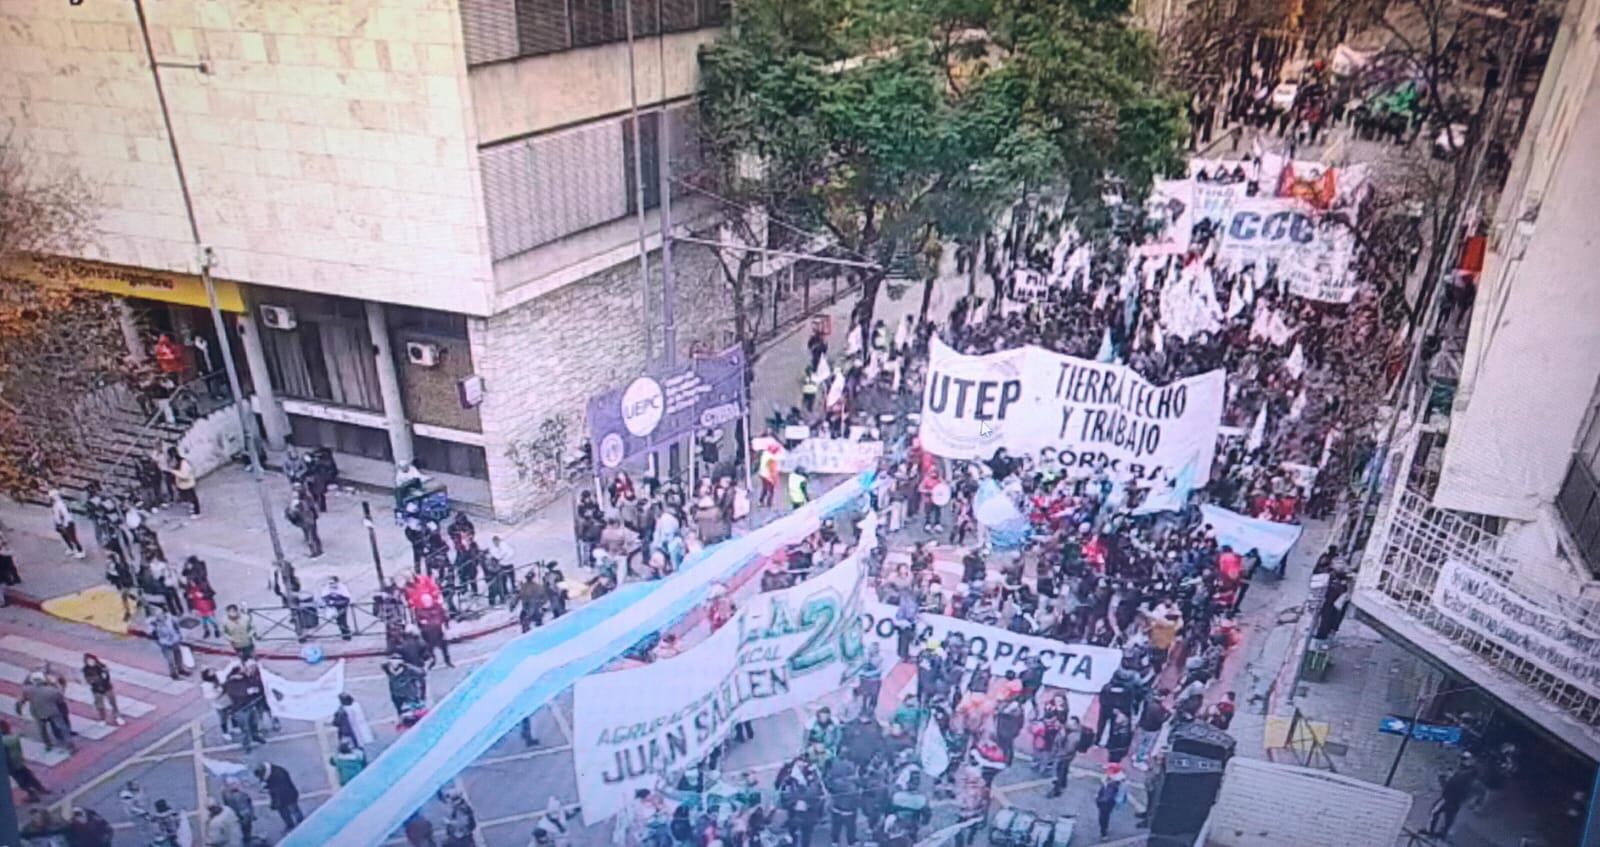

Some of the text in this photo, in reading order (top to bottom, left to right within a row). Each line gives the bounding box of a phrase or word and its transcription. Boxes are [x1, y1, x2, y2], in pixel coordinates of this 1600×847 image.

[1229, 211, 1314, 243] CCC
[624, 394, 662, 420] UEPC
[929, 371, 1022, 421] UTEP
[1126, 380, 1188, 419] TECHO
[1059, 405, 1161, 458] Y TRABAJO
[993, 640, 1093, 681] PACTA
[602, 725, 687, 784] JUAN
